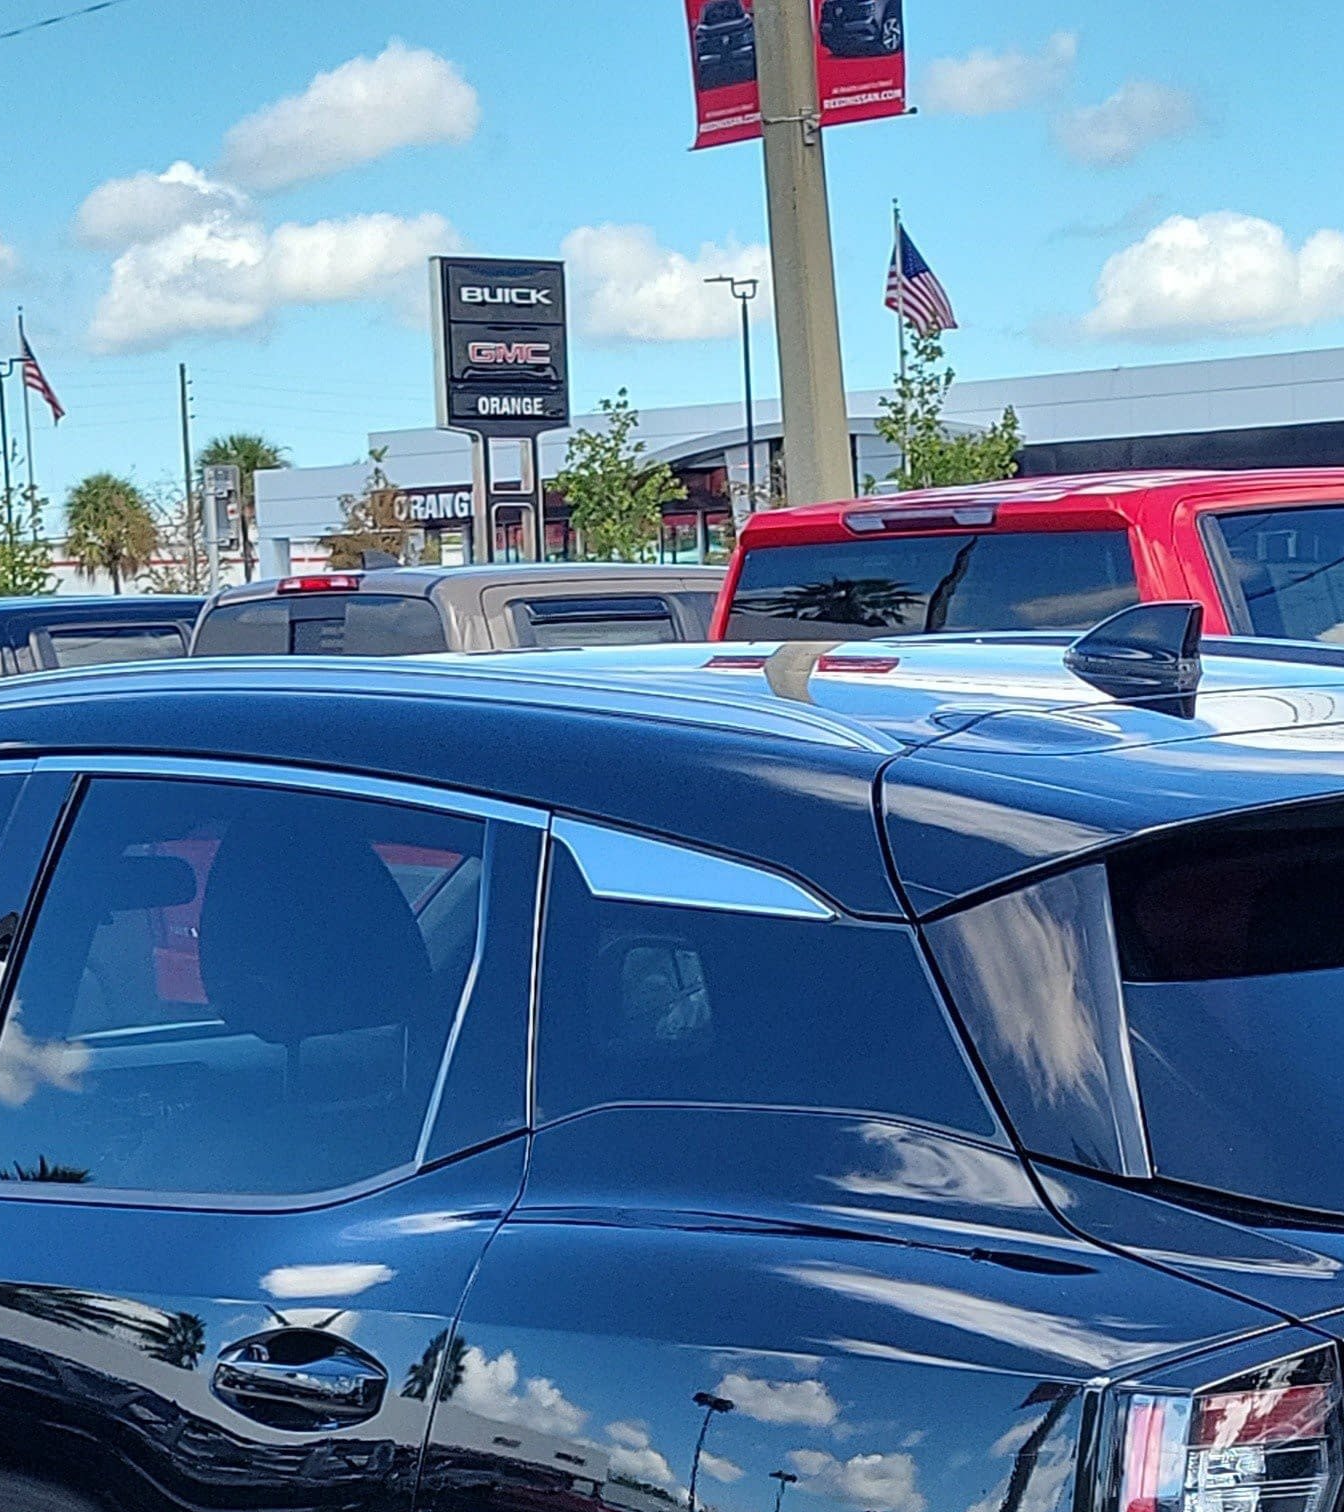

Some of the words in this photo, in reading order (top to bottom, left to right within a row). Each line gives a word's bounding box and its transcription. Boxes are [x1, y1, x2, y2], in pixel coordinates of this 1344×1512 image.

[460, 286, 553, 305] BUICK
[468, 342, 551, 364] GMC
[477, 396, 544, 415] ORANGE
